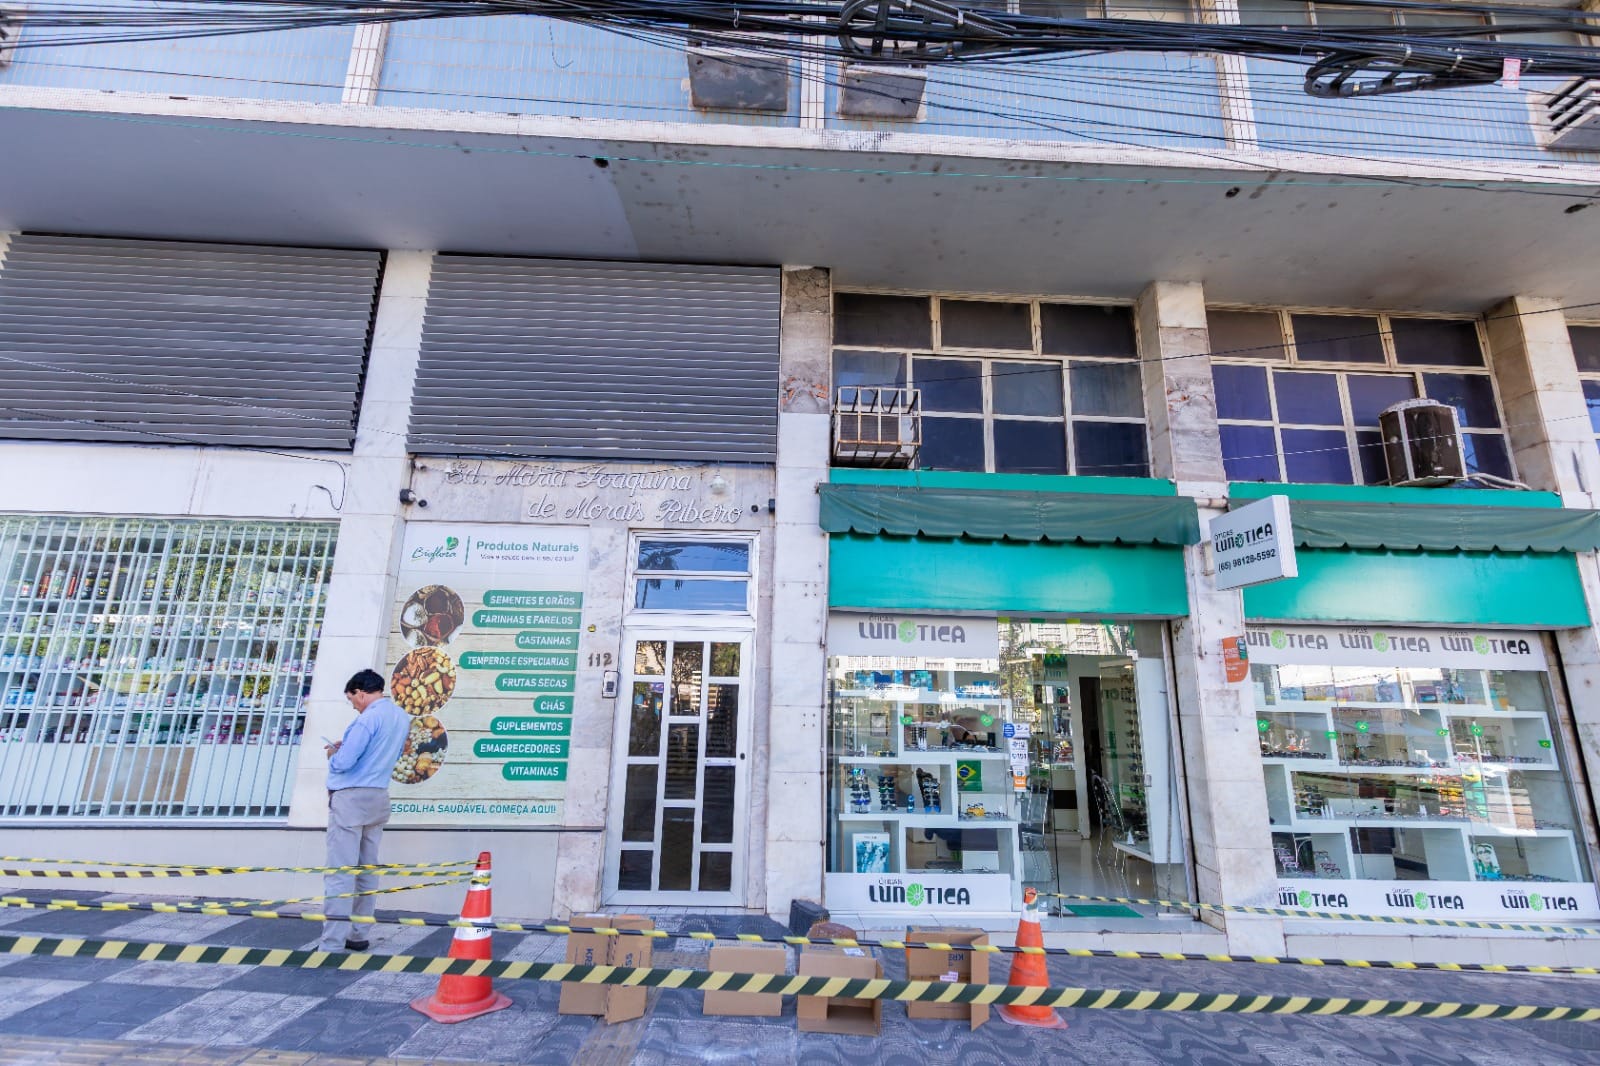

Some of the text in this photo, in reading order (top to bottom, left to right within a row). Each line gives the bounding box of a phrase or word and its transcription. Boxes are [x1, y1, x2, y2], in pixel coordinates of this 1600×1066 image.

[495, 464, 568, 487] Maria
[576, 466, 693, 497] Joaquina
[527, 494, 745, 524] de Morais Ribeiro
[476, 540, 580, 553] Produtos Naturais
[490, 595, 576, 606] SEMENTES E GRÃOS
[479, 614, 574, 625] FARINHAS E FARELOS
[518, 635, 572, 645] CASTANHAS
[1245, 630, 1329, 650] UNOTICA
[467, 656, 570, 666] TEMPEROS E ESPECIARIAS
[588, 652, 612, 667] 112
[502, 678, 568, 688] FRUTAS SECAS
[540, 700, 566, 711] CHÁS
[496, 721, 564, 731] SUPLEMENTOS
[479, 743, 561, 754] EMAGRECEDORES
[509, 766, 559, 776] VITAMINAS
[390, 803, 435, 813] ESCOLHA
[437, 802, 487, 814] SAUDÁVEL
[489, 804, 529, 816] COMEÇA
[1278, 890, 1348, 909] UNOTICA
